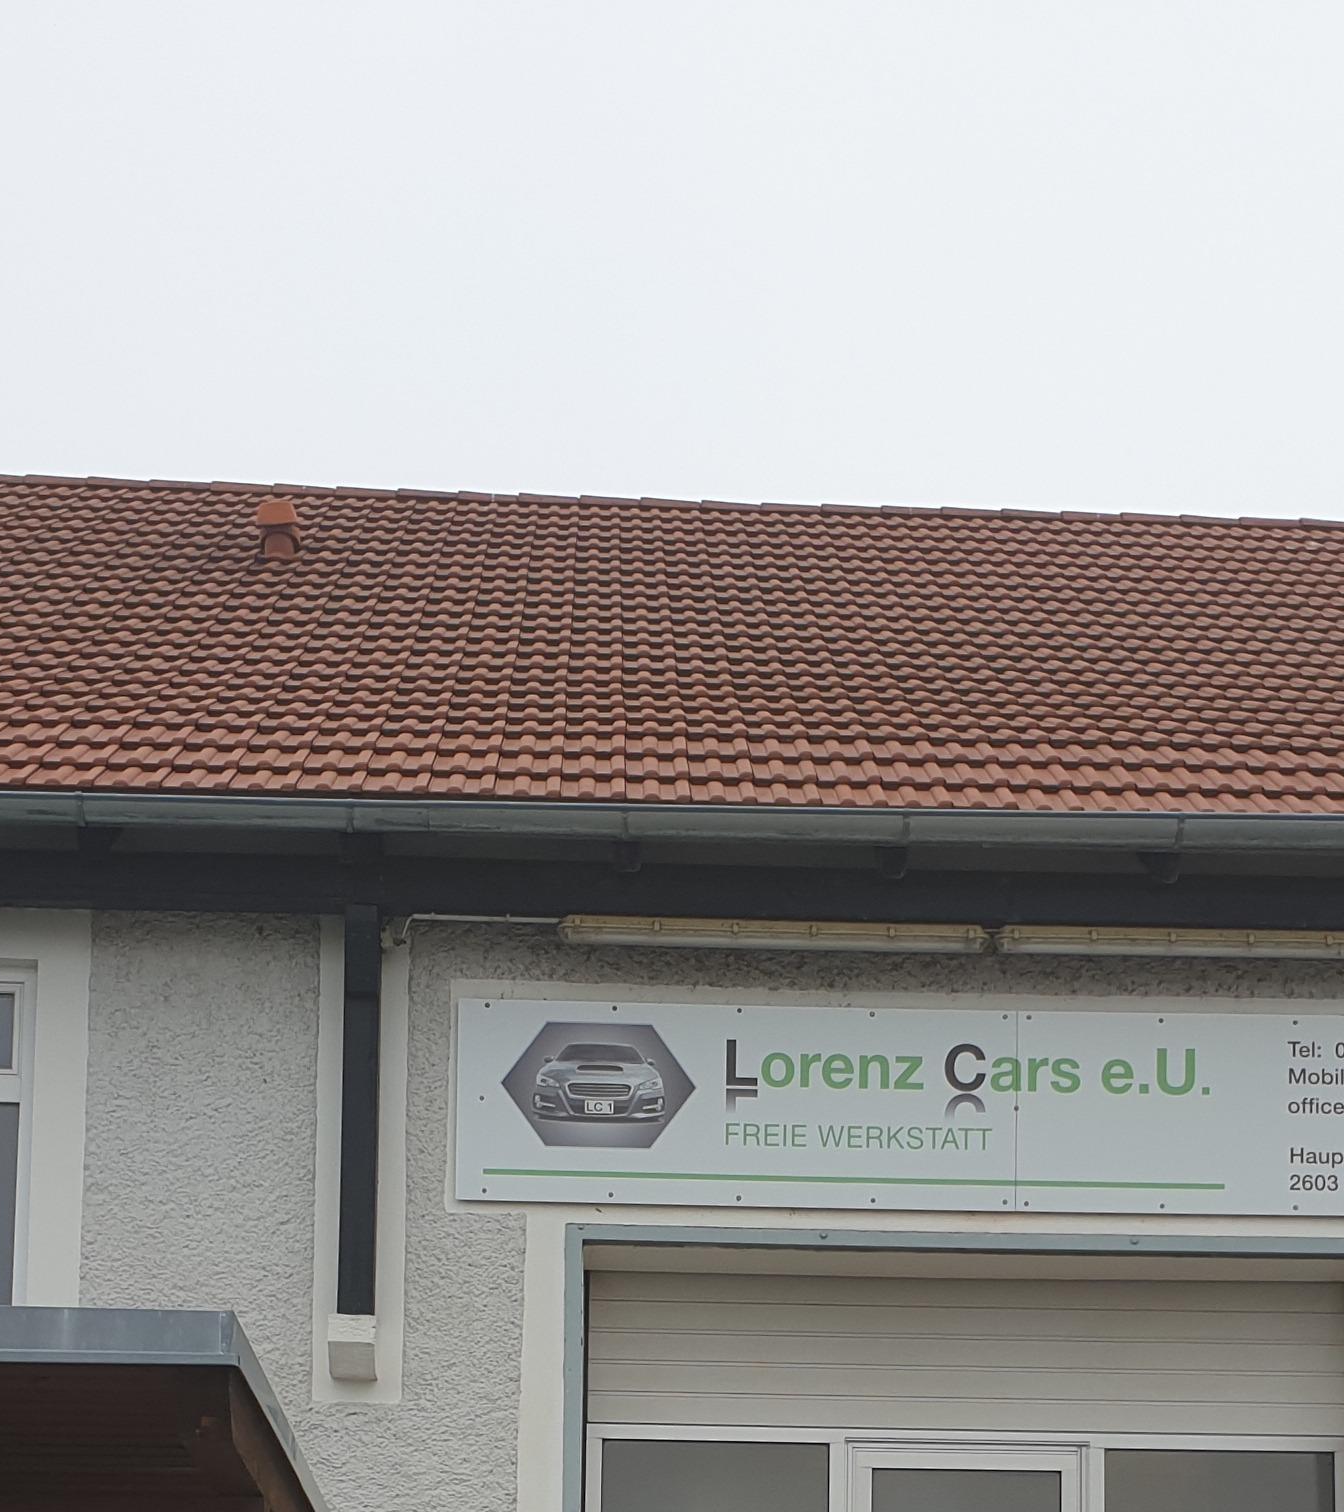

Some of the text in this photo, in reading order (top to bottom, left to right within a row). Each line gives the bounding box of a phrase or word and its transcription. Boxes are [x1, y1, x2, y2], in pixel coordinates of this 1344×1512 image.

[1287, 1040, 1322, 1059] Tel:
[725, 1038, 1211, 1096] Lorenz Cars e.U.
[724, 1122, 993, 1151] FREIE WERKSTATT
[1289, 1173, 1339, 1192] 2603
